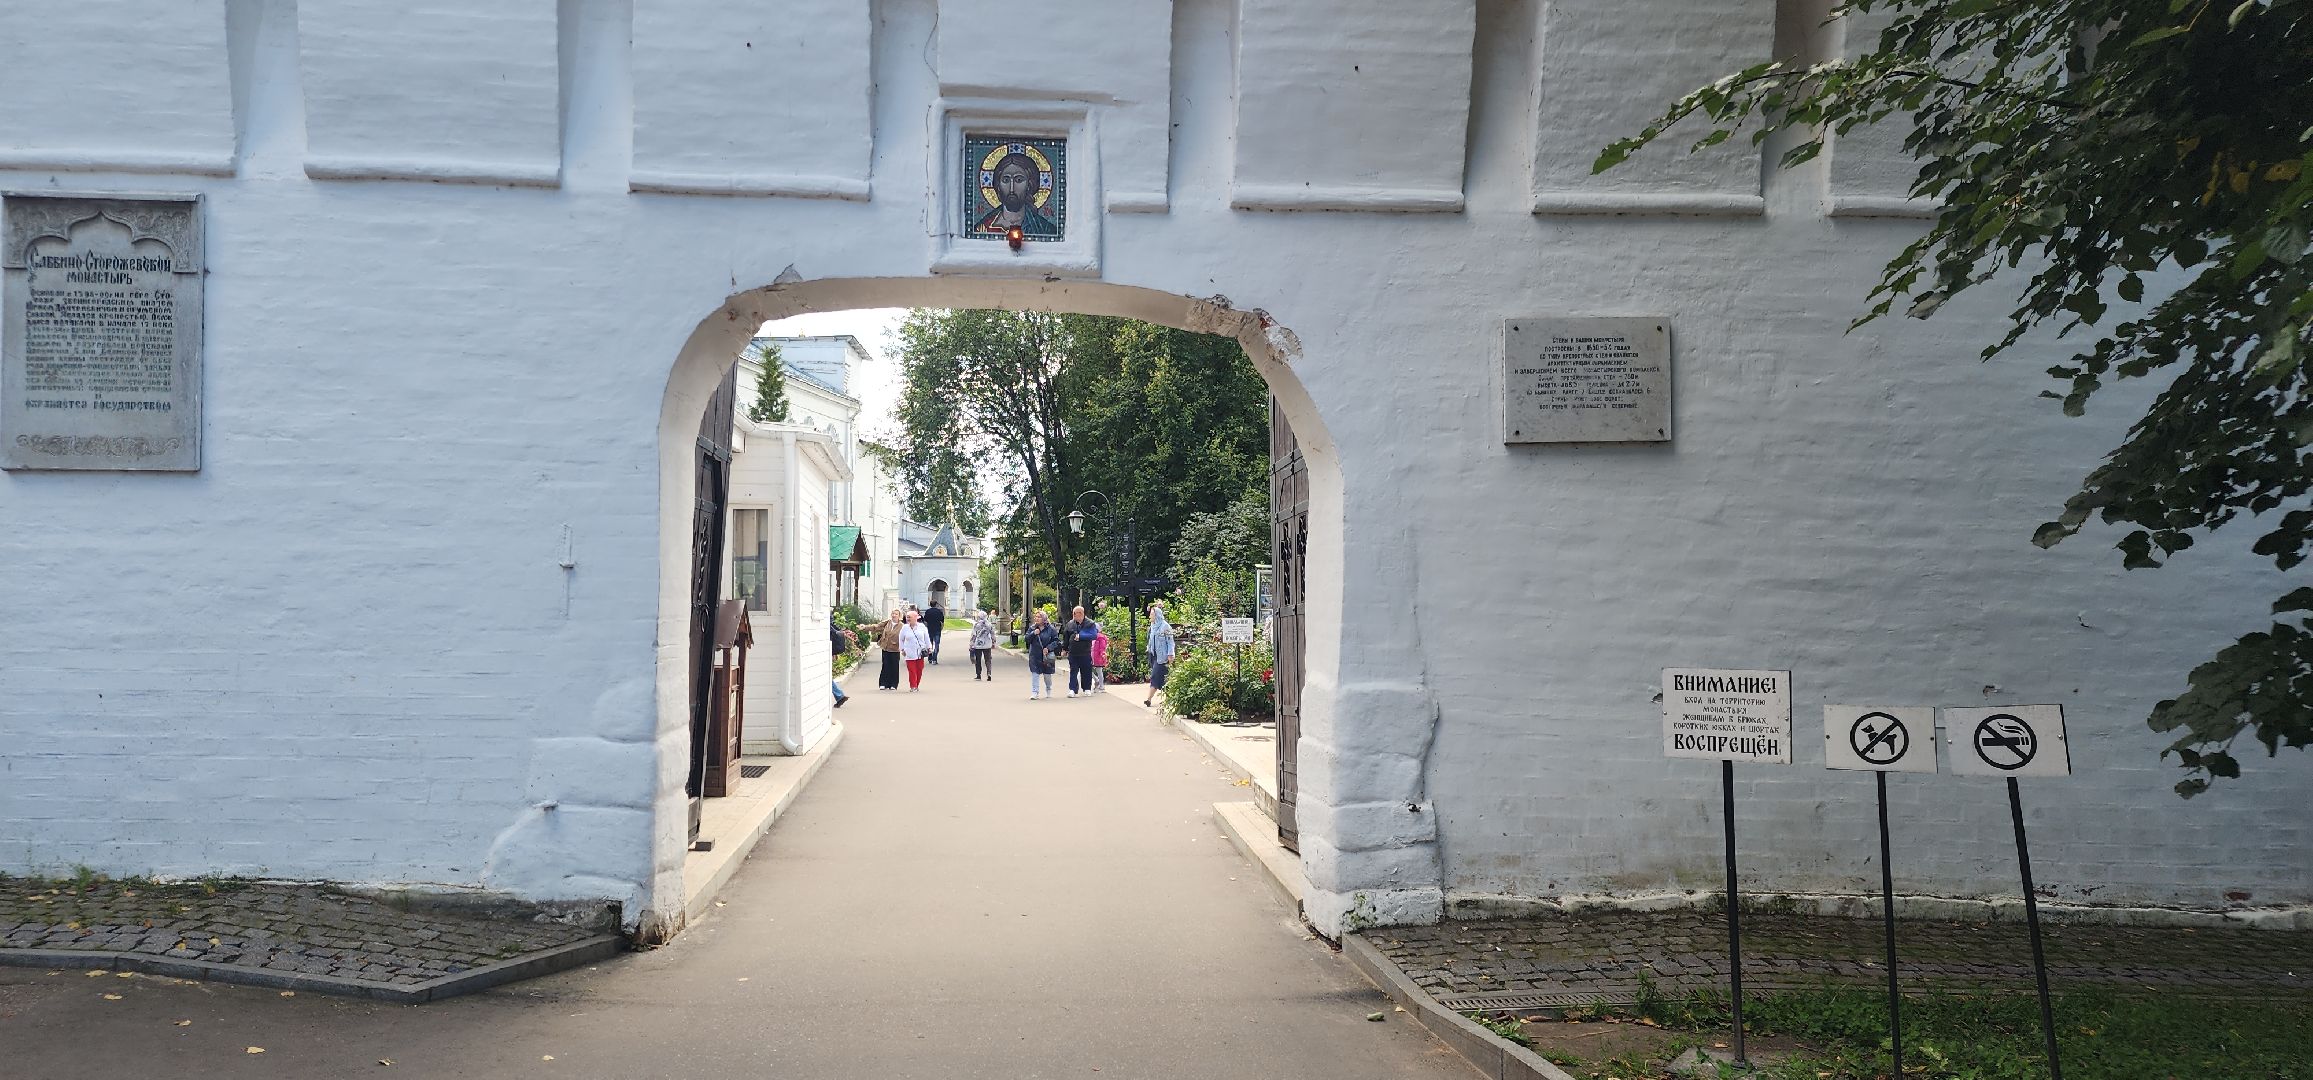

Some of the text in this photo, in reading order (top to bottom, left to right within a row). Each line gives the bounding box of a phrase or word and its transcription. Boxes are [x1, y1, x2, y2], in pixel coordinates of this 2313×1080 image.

[93, 400, 172, 412] государством
[1674, 674, 1777, 694] ВНИМАНИЕ!
[1684, 696, 1766, 706] ВХОД НА ТЕРРИТОРИЮ
[1702, 706, 1747, 715] МОНАСТЫРЯ
[1682, 713, 1725, 723] ЖЕНЩИНАМ
[1729, 715, 1734, 723] В
[1673, 722, 1709, 730] КОРОТКИХ
[1712, 724, 1737, 732] ЮБКАХ
[1748, 726, 1780, 734] ШОРТАХ
[1674, 733, 1778, 757] ВОСПРЕЩЁН
